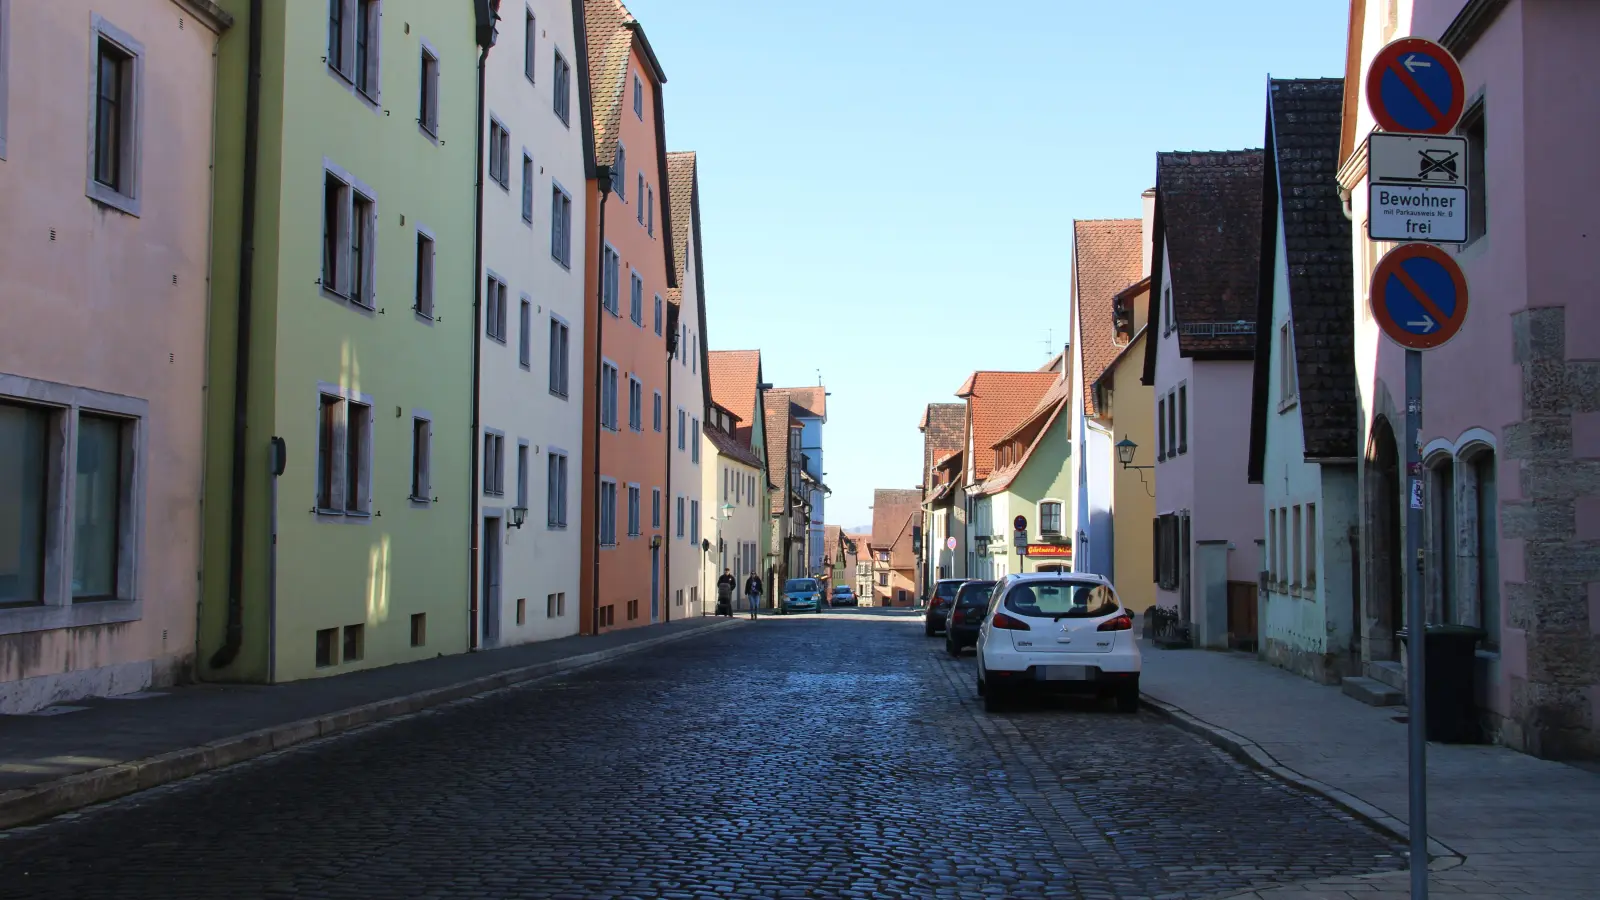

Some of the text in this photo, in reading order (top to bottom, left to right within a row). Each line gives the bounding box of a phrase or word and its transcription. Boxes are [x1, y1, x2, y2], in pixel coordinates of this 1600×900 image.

[1380, 191, 1456, 208] Bewohner
[1396, 209, 1435, 217] Parkausweis
[1406, 219, 1431, 233] frei
